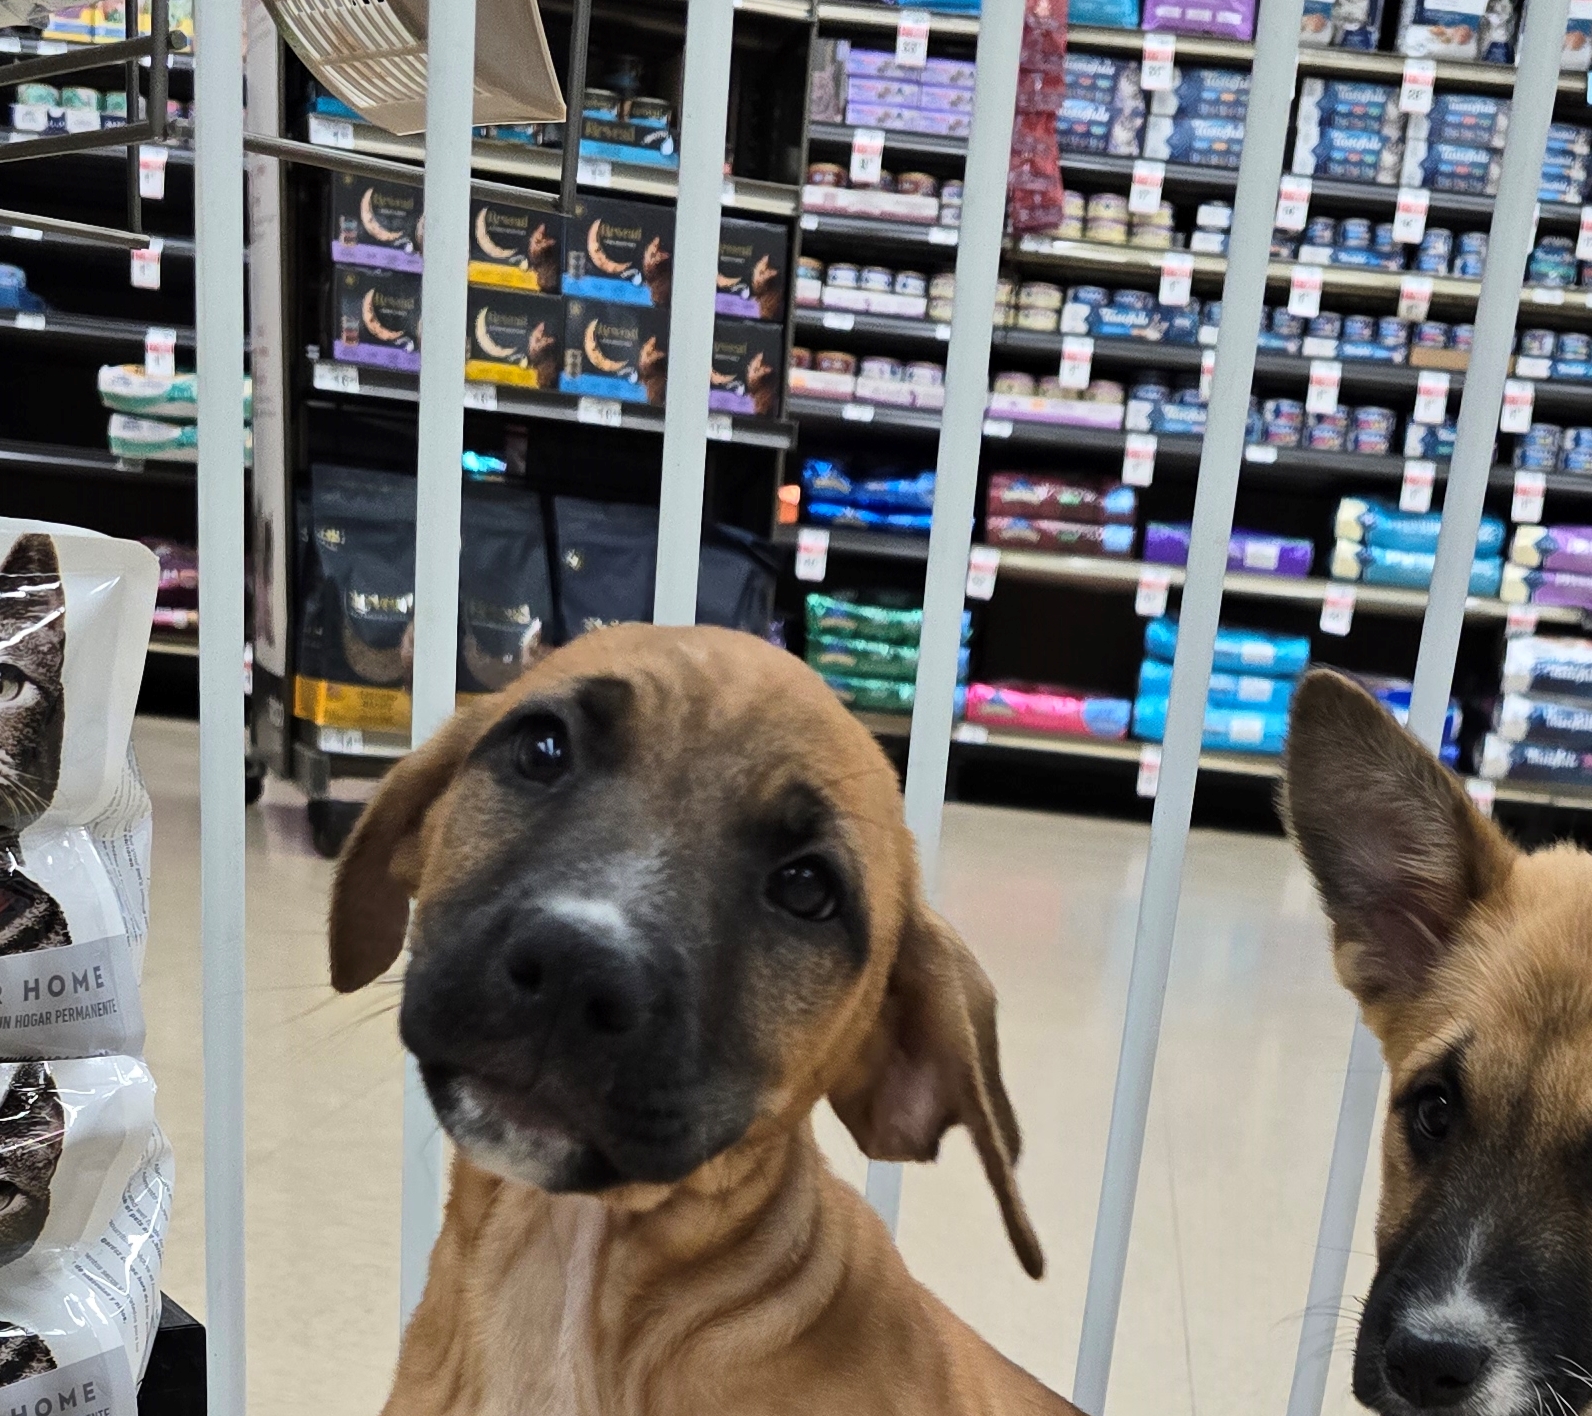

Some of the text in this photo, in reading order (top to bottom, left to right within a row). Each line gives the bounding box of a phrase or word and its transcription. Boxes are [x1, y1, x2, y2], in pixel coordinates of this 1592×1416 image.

[23, 965, 105, 1001] HOME
[15, 1011, 52, 1029] HOGAR
[55, 998, 117, 1024] PERMANENTE
